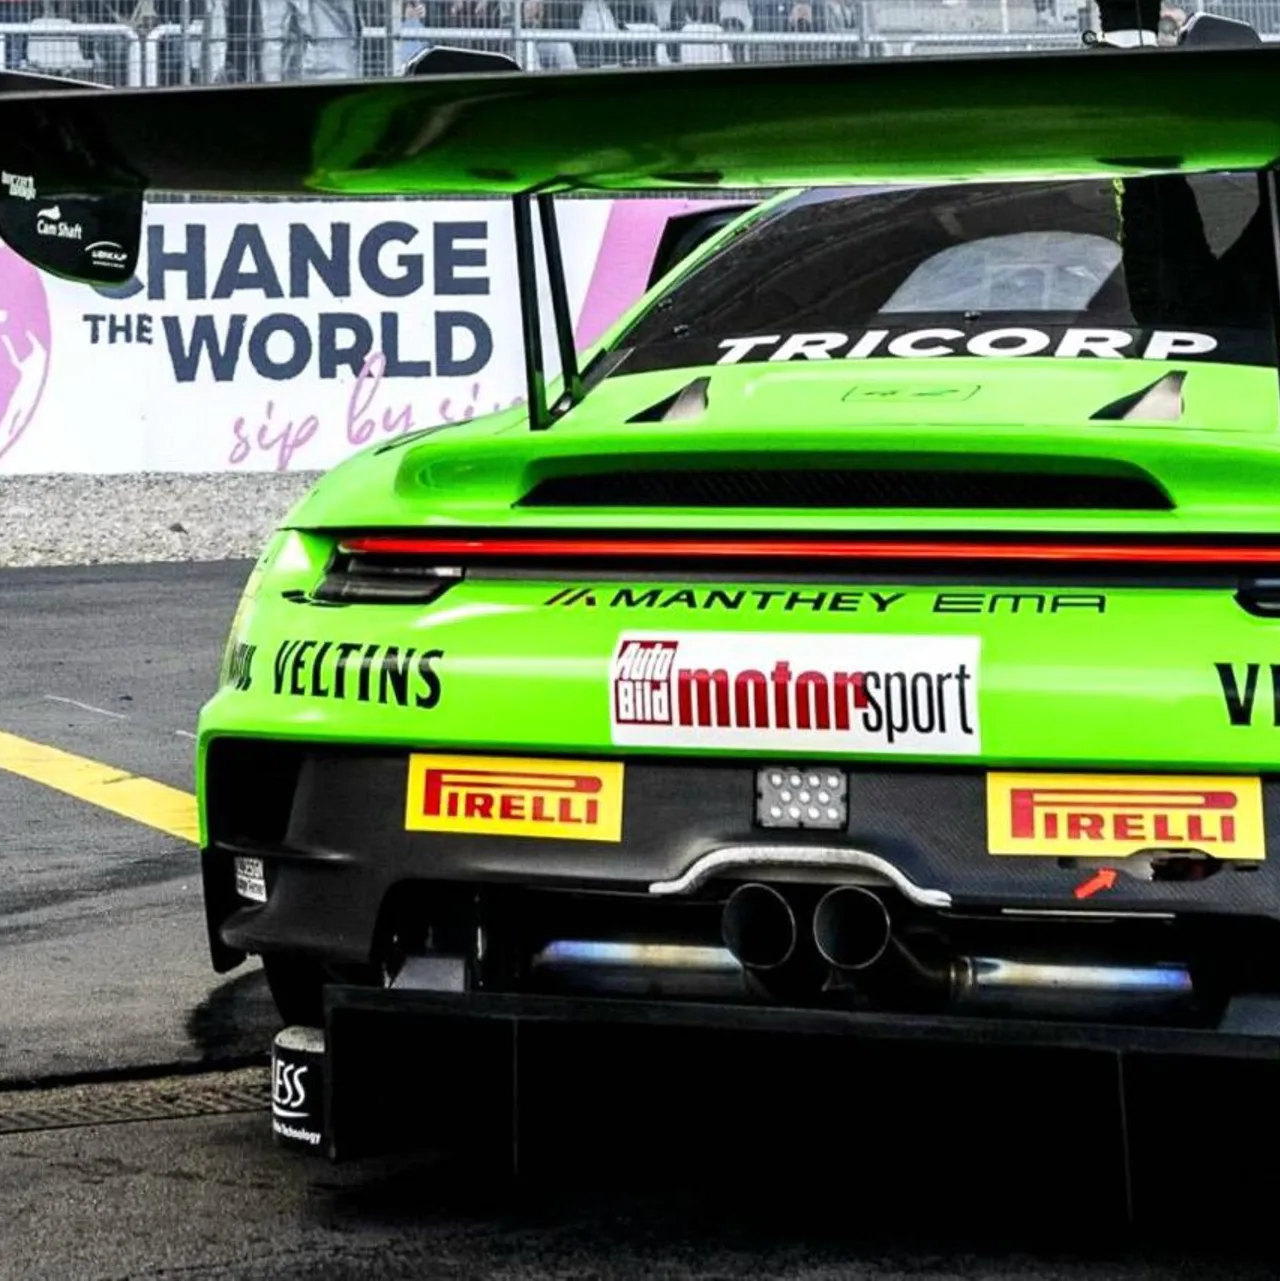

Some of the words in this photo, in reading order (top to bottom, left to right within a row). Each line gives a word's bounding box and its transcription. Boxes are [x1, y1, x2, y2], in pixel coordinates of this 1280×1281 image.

[36, 219, 58, 236] Cam
[58, 222, 83, 240] Shaft
[92, 220, 491, 301] HANGE
[82, 312, 154, 345] THE
[161, 310, 494, 384] WORLD
[716, 327, 1219, 366] TRICORP
[228, 399, 321, 472] sip
[610, 588, 907, 613] MANTHEY
[932, 593, 1107, 614] EMA
[273, 640, 445, 710] VELTINS
[617, 641, 676, 680] Auto
[618, 679, 669, 722] Bild
[423, 768, 603, 825] PIRELLI
[1010, 788, 1238, 843] PIRELLI
